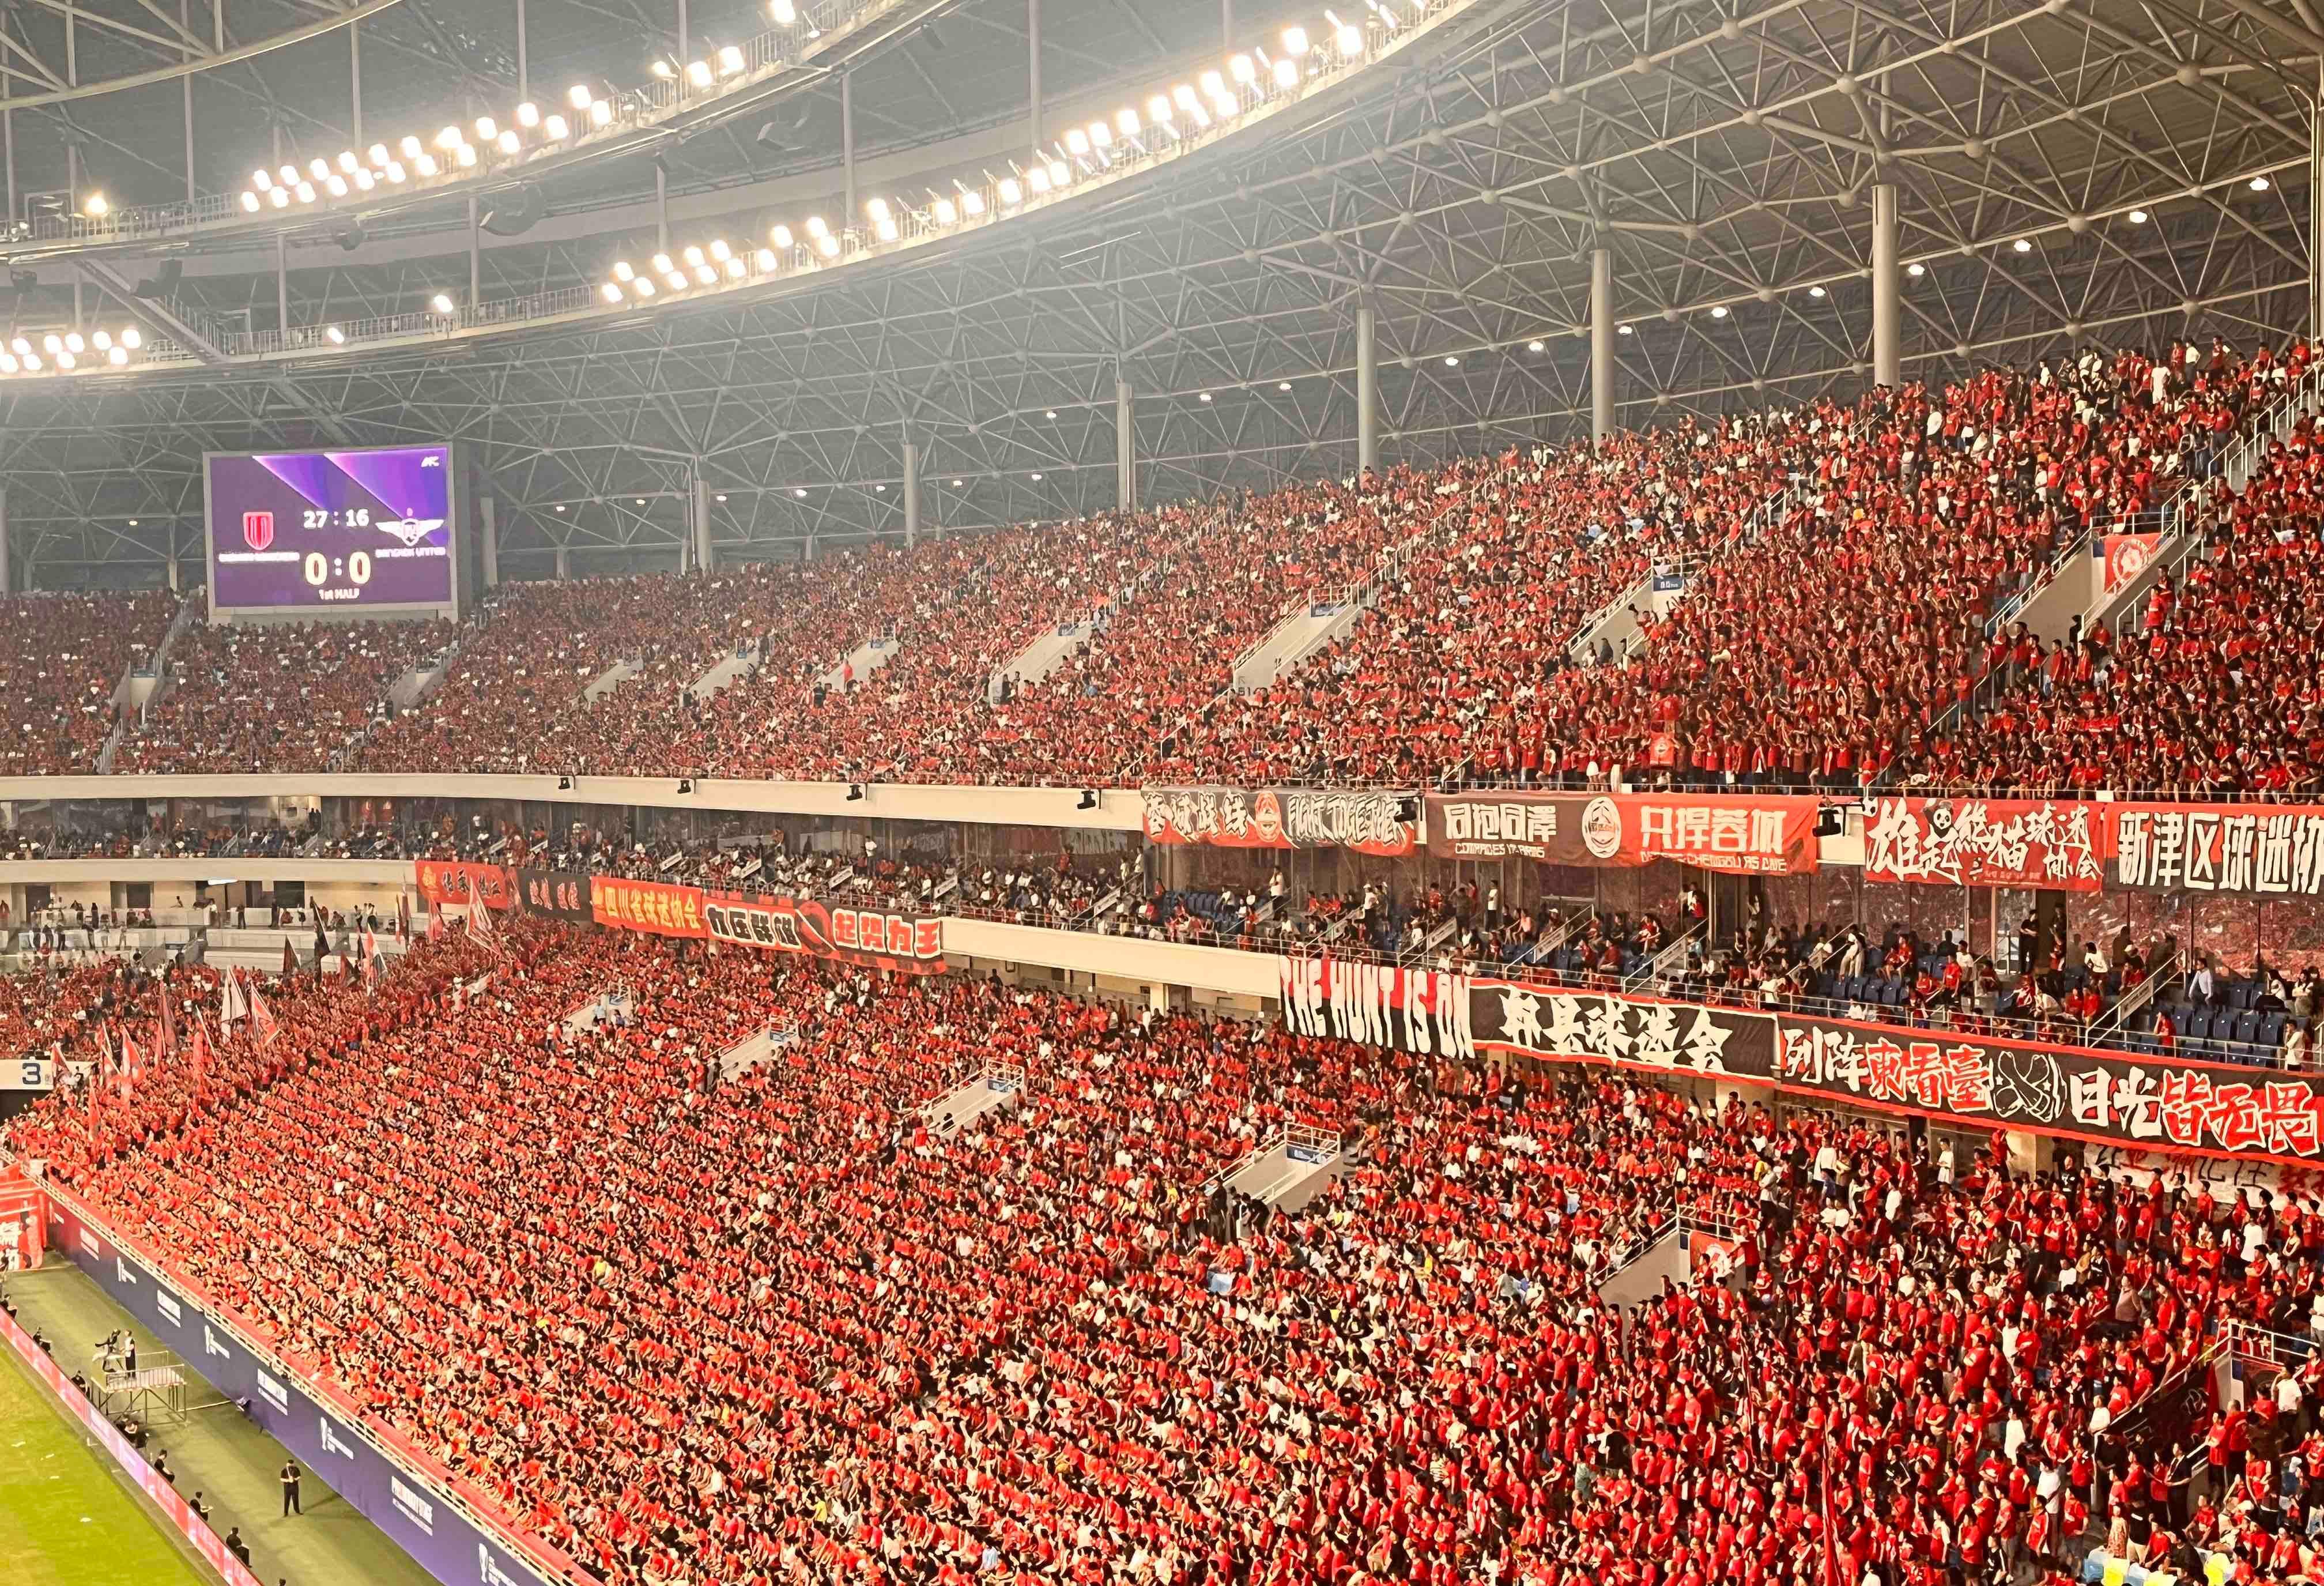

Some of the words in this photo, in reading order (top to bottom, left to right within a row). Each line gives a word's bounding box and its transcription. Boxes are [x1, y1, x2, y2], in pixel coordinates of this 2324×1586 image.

[1279, 955, 1326, 1037] THE
[1330, 960, 1395, 1048] HUNT
[1403, 969, 1431, 1054] IS
[1435, 973, 1476, 1060] ON
[22, 1063, 41, 1085] 3
